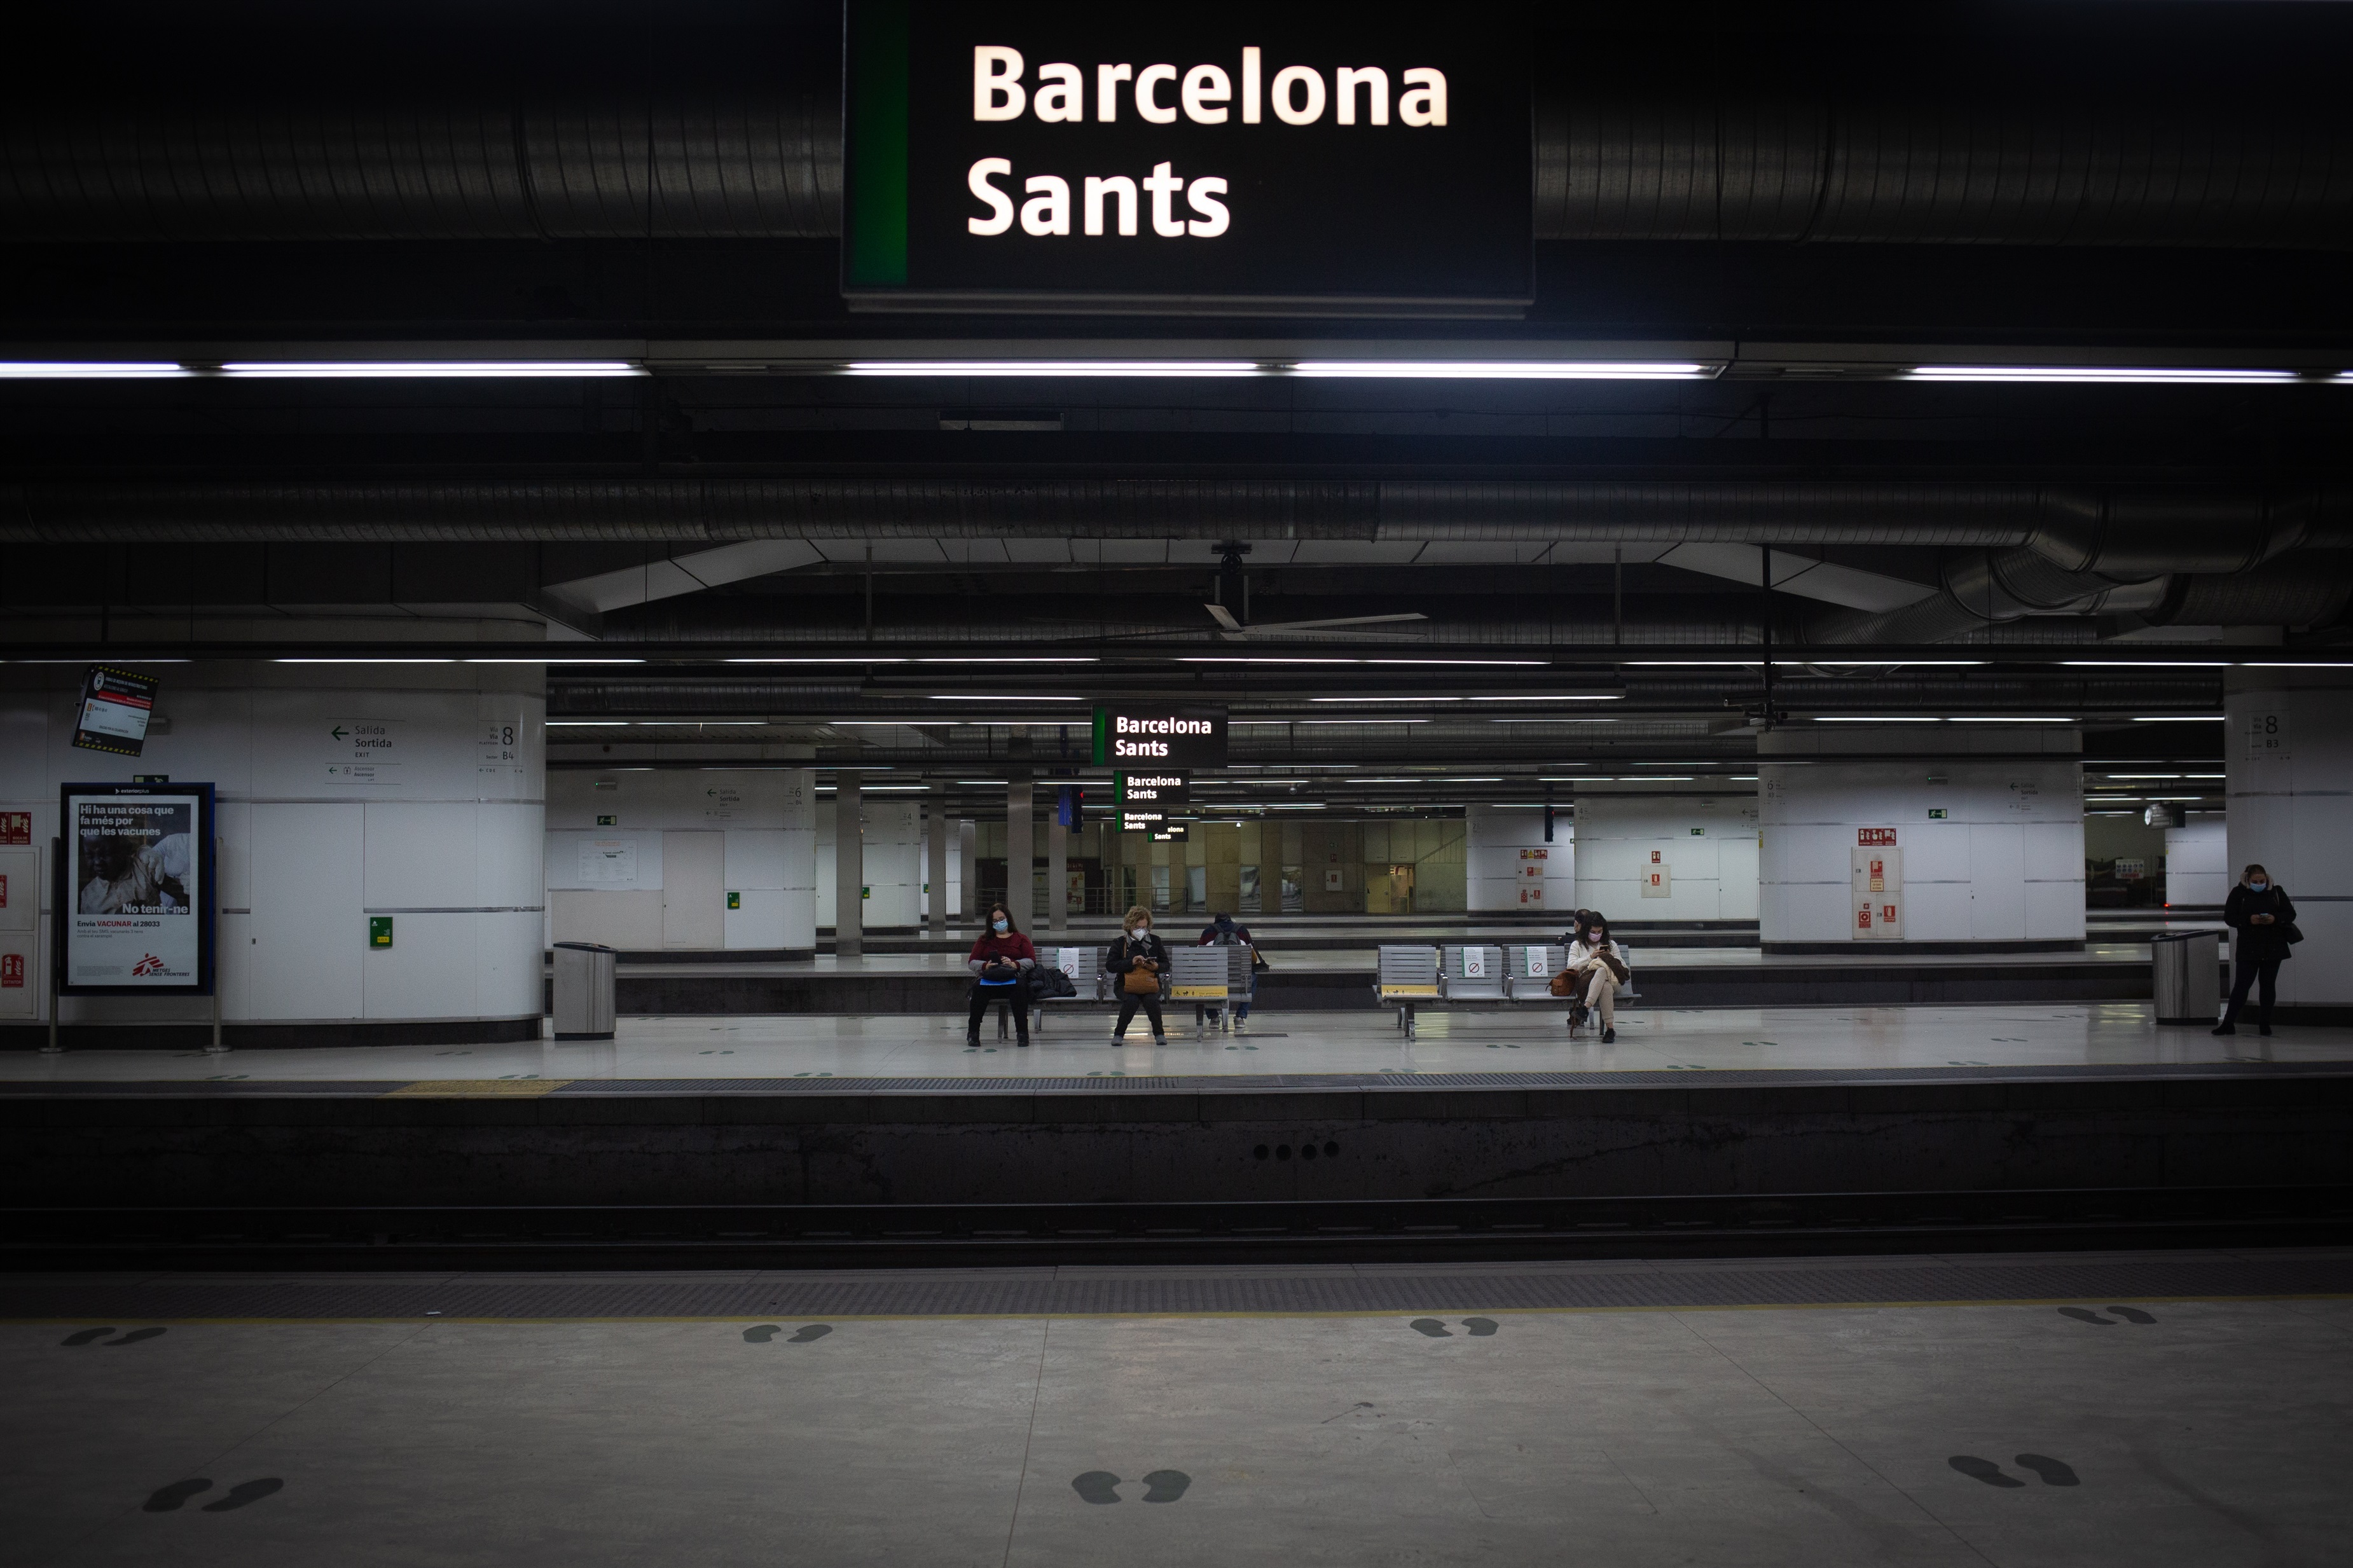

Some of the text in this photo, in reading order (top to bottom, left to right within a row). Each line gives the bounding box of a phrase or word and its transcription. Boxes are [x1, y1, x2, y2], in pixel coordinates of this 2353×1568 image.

[974, 45, 1447, 127] Barcelona
[967, 157, 1230, 237] Sants
[355, 726, 385, 734] Salida
[1117, 717, 1211, 734] Barcelona
[2266, 716, 2277, 734] 8
[502, 726, 513, 745] 8
[355, 739, 392, 748] Sortida
[1115, 739, 1168, 756] Sants
[2267, 739, 2279, 748] B3
[502, 752, 514, 760] B4
[1128, 776, 1181, 786] Barcelona
[1768, 780, 1773, 790] 6
[795, 787, 801, 797] 6
[1127, 789, 1157, 799] Sants
[80, 805, 91, 815] Hi
[93, 805, 106, 815] ha
[155, 807, 174, 816] que
[80, 816, 134, 827] fa més por
[80, 827, 160, 837] que les vacunes
[122, 904, 188, 914] No tenir-ne
